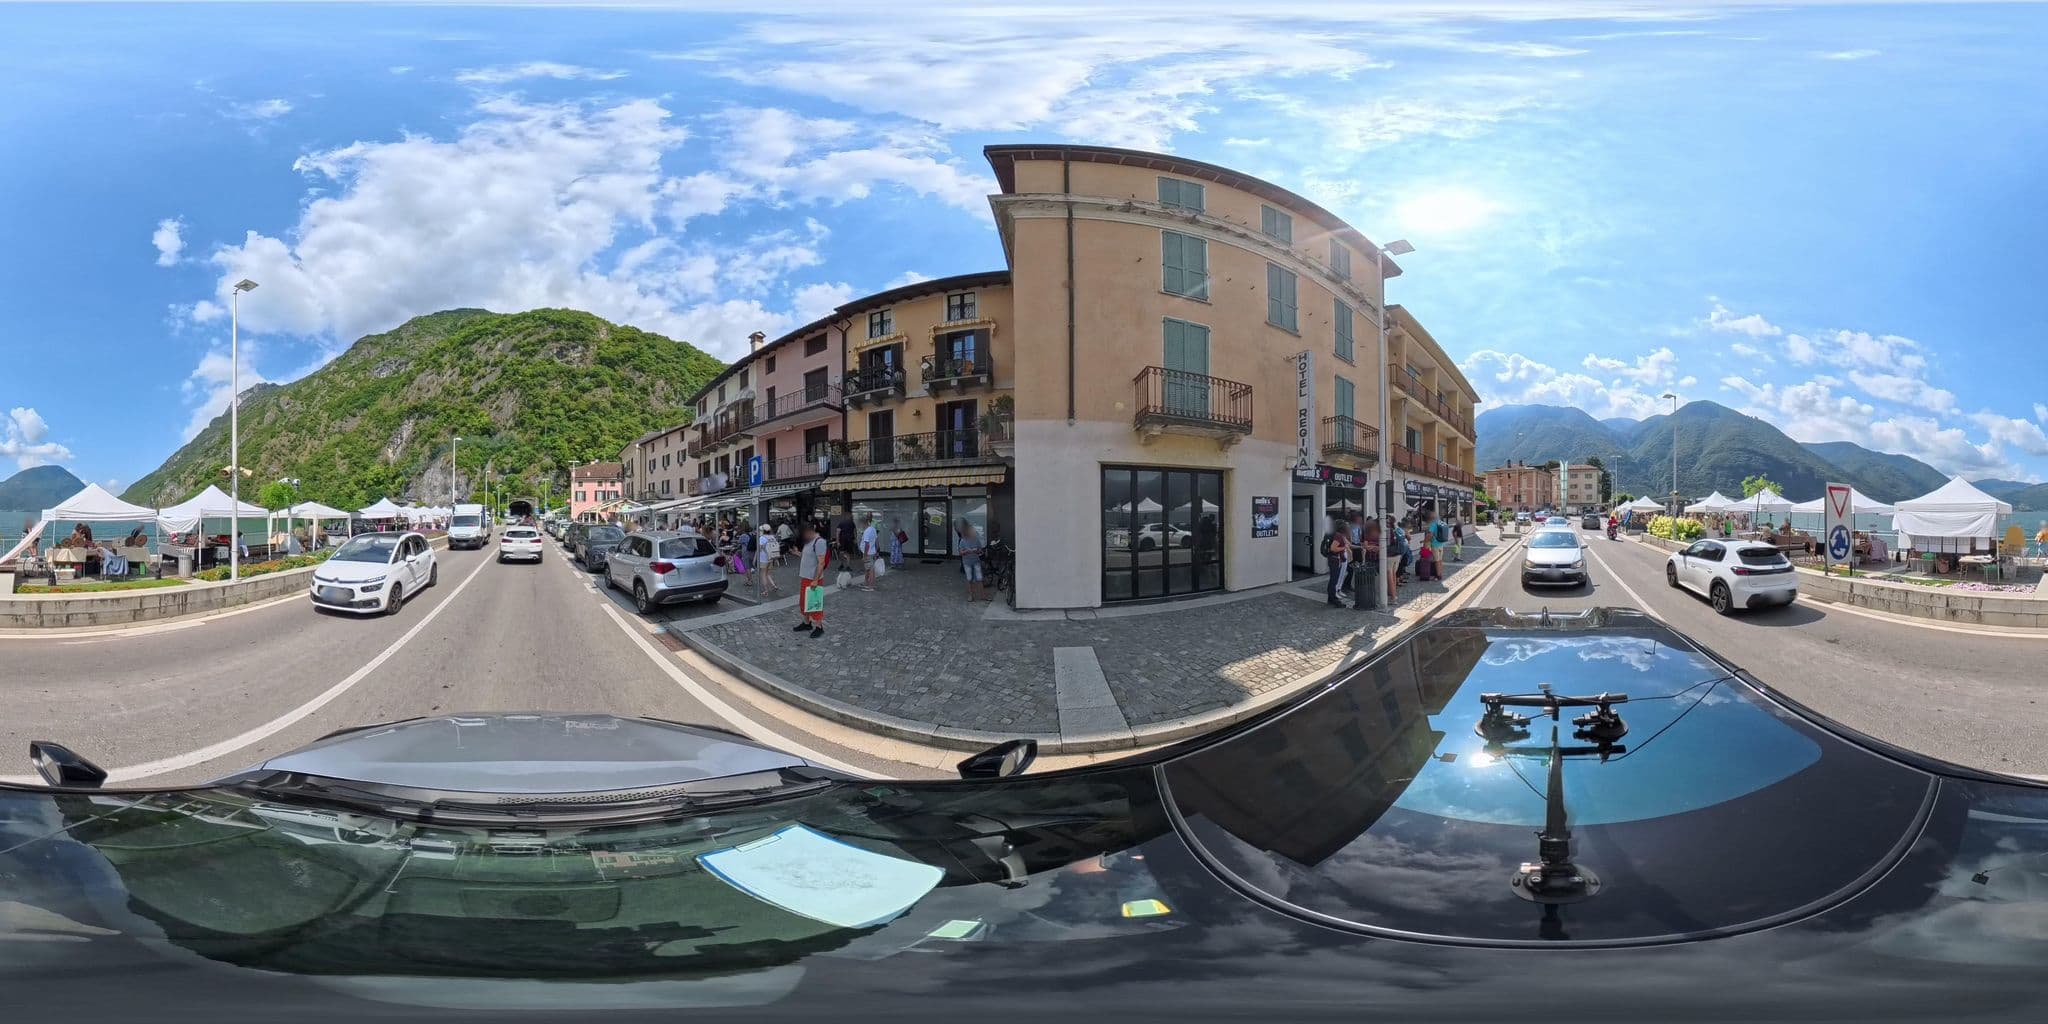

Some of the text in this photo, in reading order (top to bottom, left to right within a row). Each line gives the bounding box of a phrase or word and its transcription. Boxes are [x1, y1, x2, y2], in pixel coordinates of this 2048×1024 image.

[1299, 353, 1309, 467] HOTEL REGINA
[751, 460, 759, 484] P
